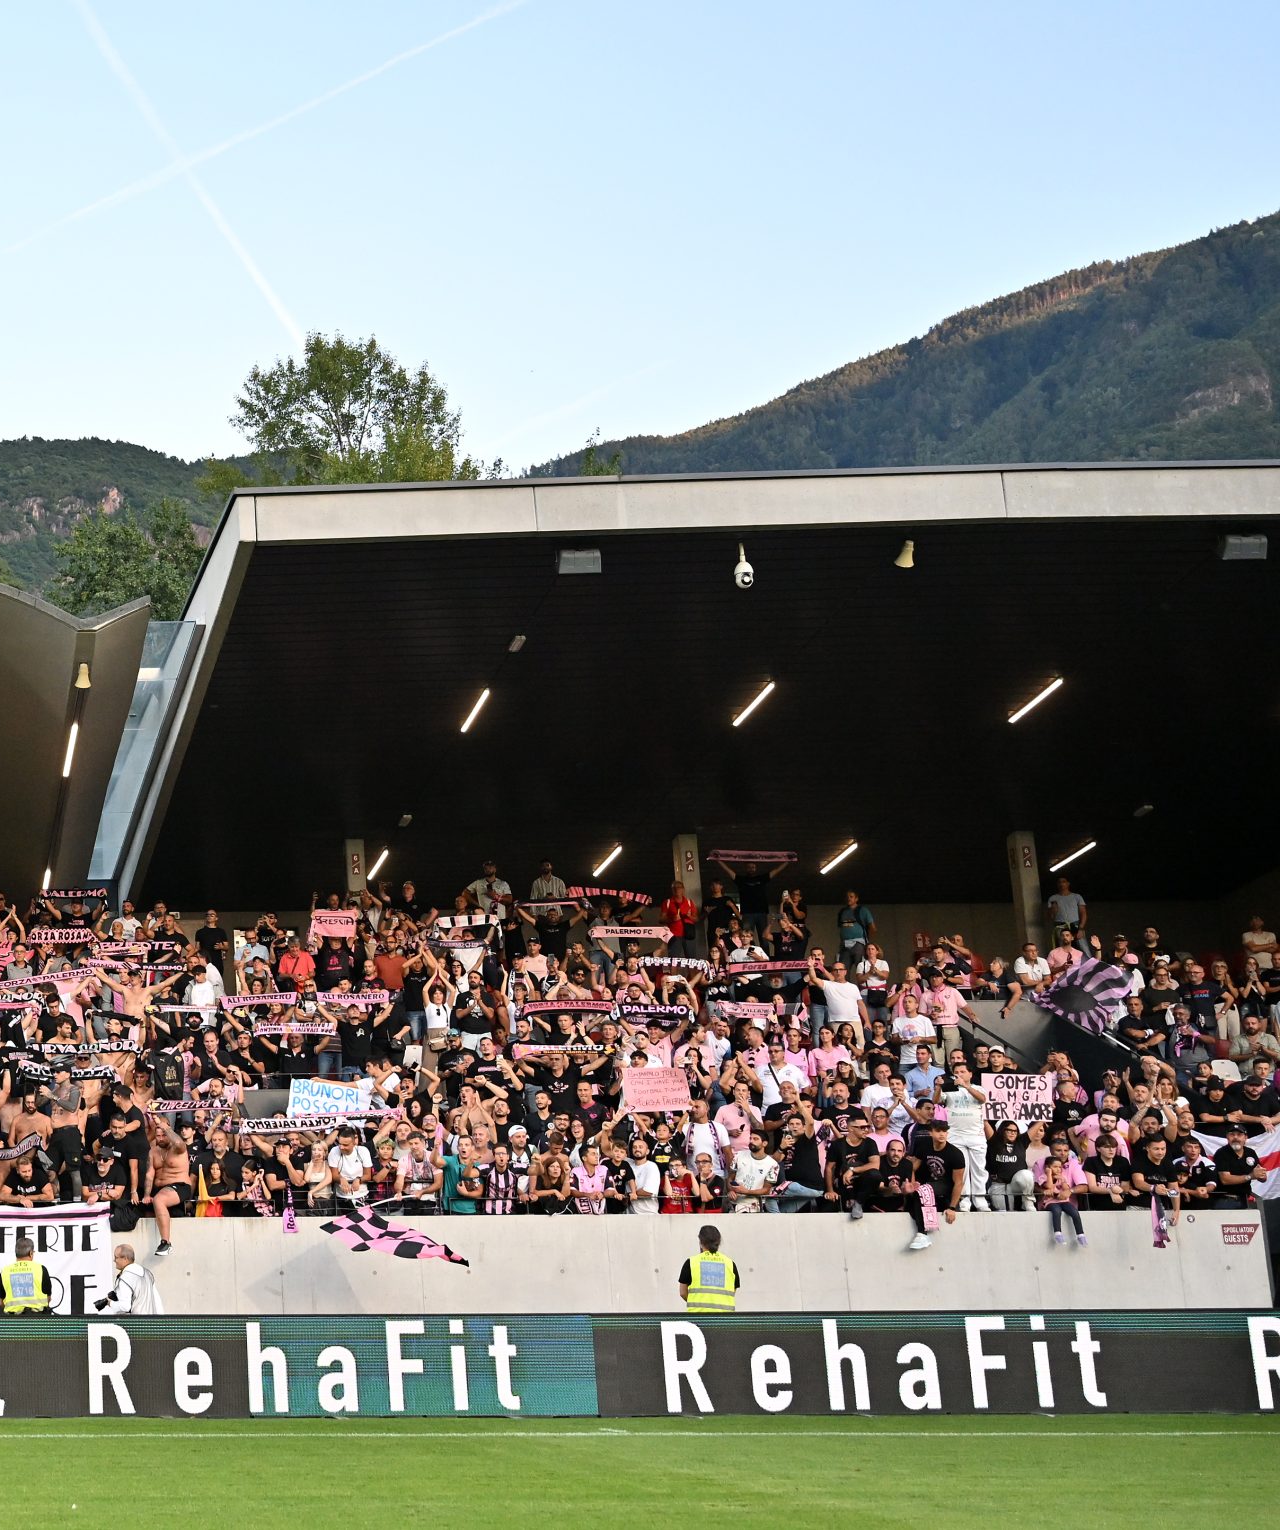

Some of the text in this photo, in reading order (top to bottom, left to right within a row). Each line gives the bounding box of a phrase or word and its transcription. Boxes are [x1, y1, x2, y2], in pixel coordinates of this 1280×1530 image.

[314, 916, 354, 926] BRESCIA
[31, 931, 56, 941] ORZA
[0, 969, 93, 989] FORZA PALERMO
[227, 994, 292, 1004] ALI ROSANERO
[622, 1005, 688, 1015] PALERMO
[530, 1044, 604, 1052] PALERMO
[993, 1075, 1047, 1091] GOMES
[292, 1079, 359, 1105] BRUNORI
[292, 1096, 340, 1113] POSSO
[985, 1102, 1009, 1120] PER
[1223, 1234, 1249, 1243] GUESTS
[88, 1319, 520, 1414] RehaFit
[660, 1315, 1108, 1412] RehaFit
